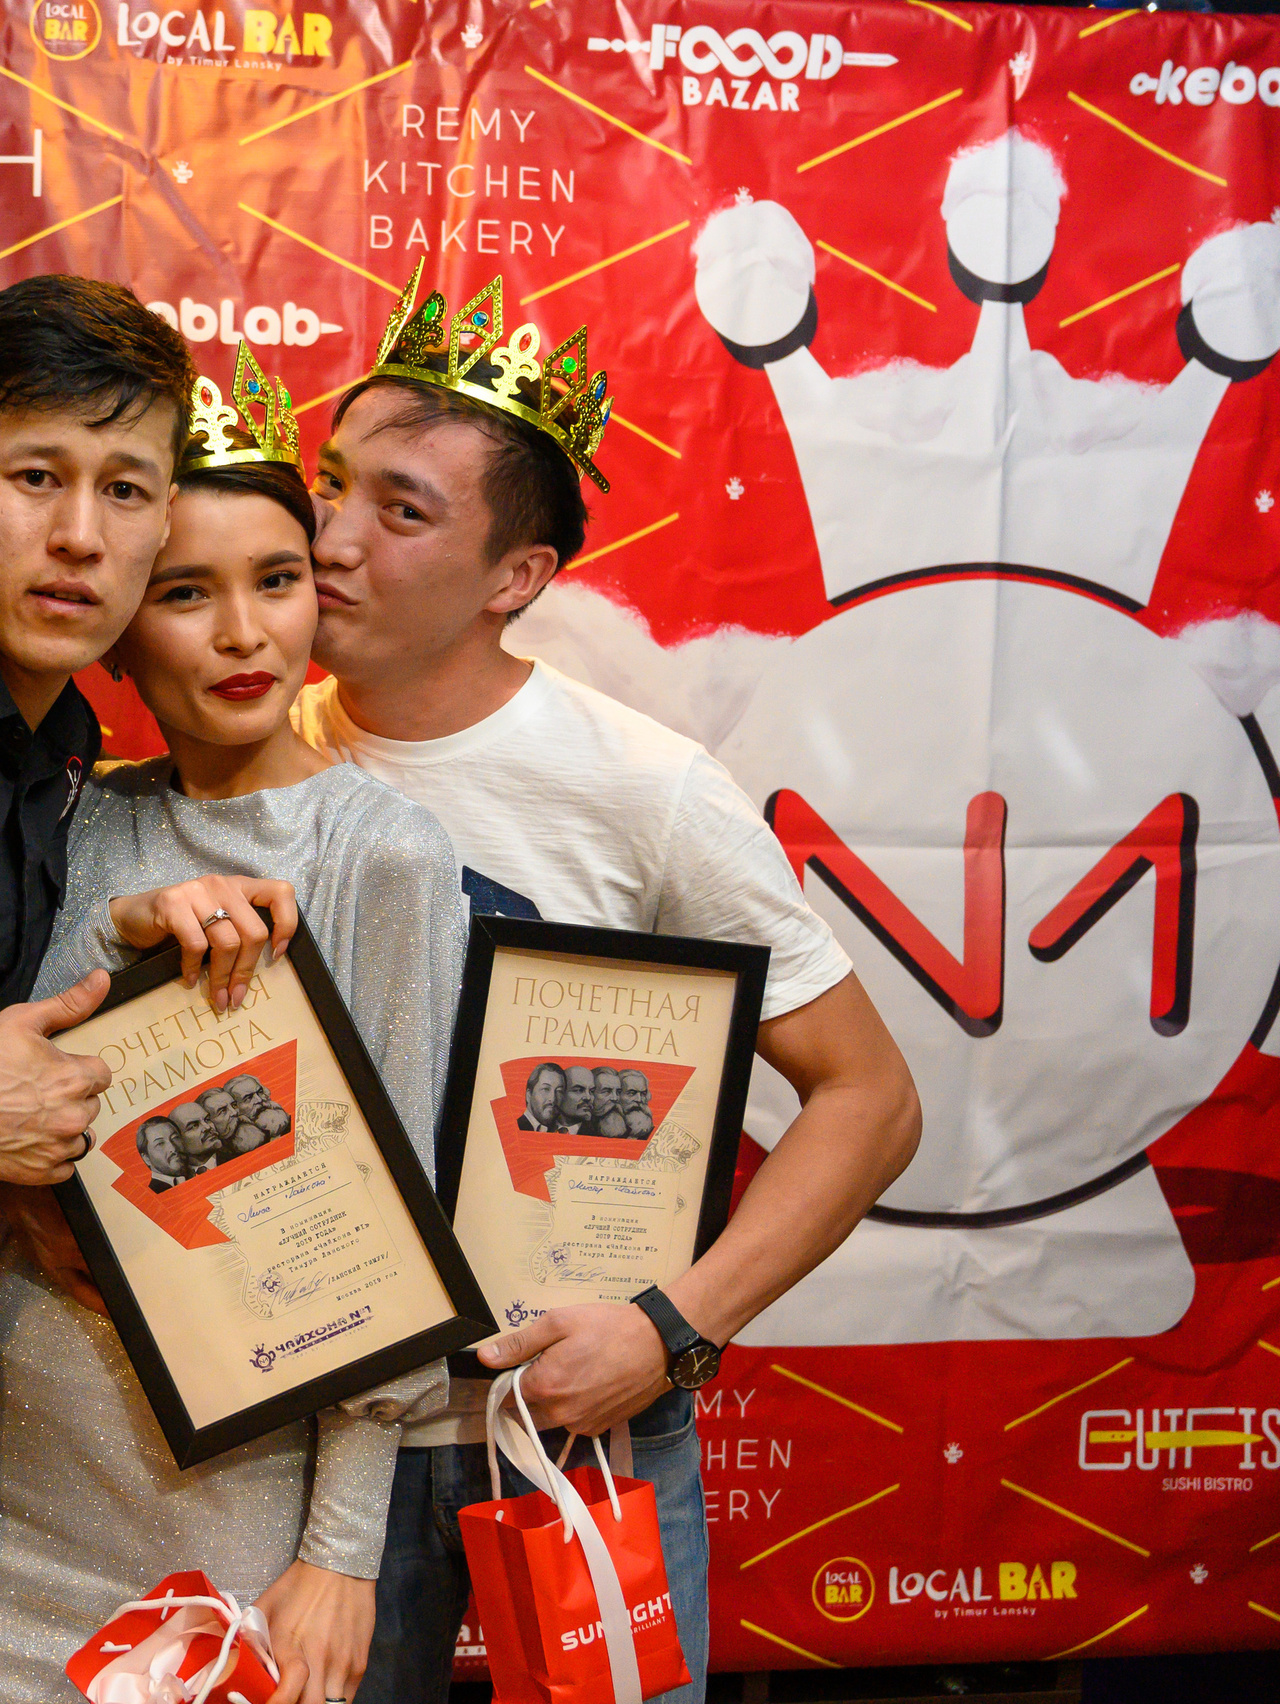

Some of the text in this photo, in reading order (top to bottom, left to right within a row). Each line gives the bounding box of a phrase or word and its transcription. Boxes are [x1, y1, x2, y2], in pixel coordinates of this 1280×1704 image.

[44, 18, 88, 41] BAR
[45, 3, 87, 19] LOCAL
[117, 3, 333, 56] LOCAL BAR
[167, 55, 283, 72] by Timur Lansky
[682, 75, 800, 112] BAZAR
[402, 104, 535, 143] REMY
[363, 159, 575, 203] KITCHEN
[369, 214, 566, 257] BAKERY
[513, 977, 701, 1022] ПОЧЕТНАЯ
[98, 974, 272, 1074] ОЧЕТНЯ
[525, 1015, 680, 1057] ГРАМОТА
[101, 1019, 275, 1116] ГРАМОТА
[253, 1162, 328, 1200] НАГРАЖДАЕТСЯ
[588, 1175, 657, 1186] НАГРАЖДАЕТСЯ
[288, 1257, 318, 1273] Тимура
[695, 1388, 756, 1419] MY
[1078, 1407, 1280, 1471] CUTFIS
[1162, 1477, 1253, 1491] SUSHI BISTRO
[825, 1571, 862, 1584] LOCAL
[825, 1584, 863, 1604] BAR
[888, 1560, 1077, 1605] LOCAL BAR
[934, 1606, 1036, 1619] by Timur Lansky
